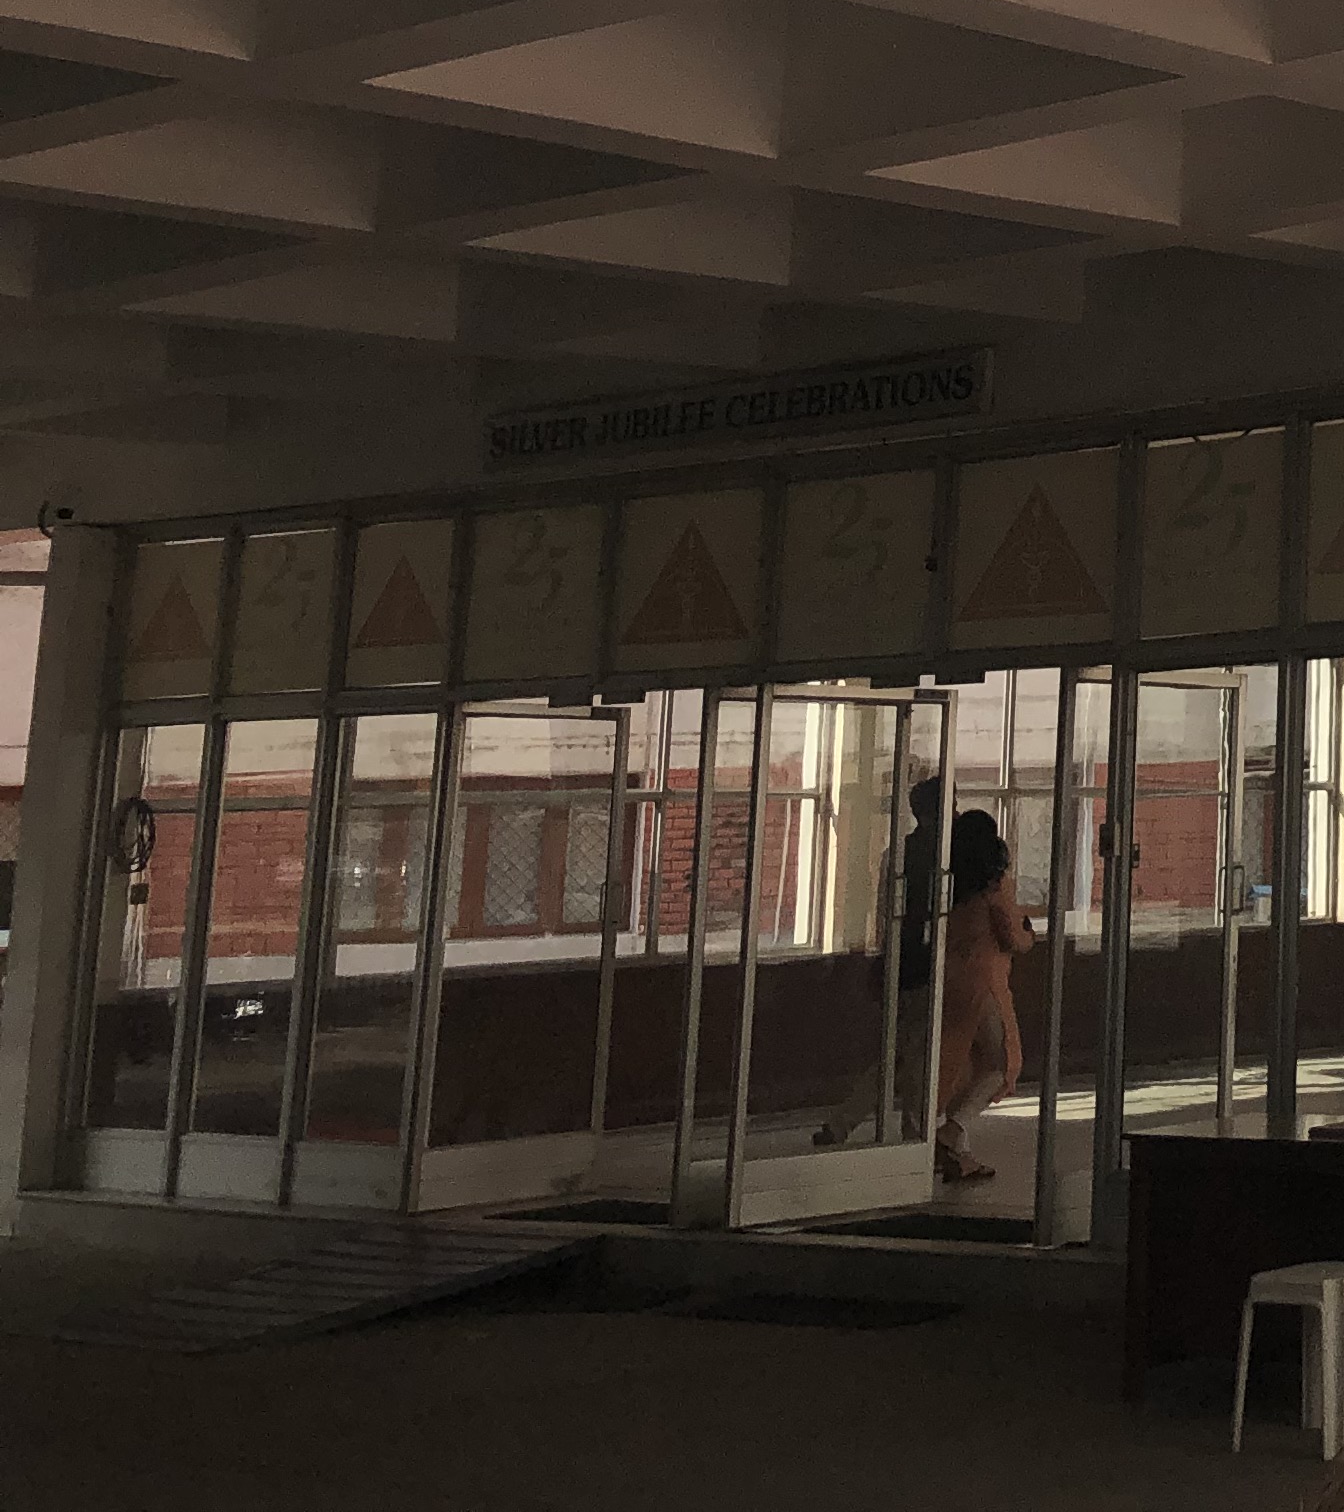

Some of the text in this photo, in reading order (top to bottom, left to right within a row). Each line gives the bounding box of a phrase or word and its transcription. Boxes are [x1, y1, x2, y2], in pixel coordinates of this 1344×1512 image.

[489, 365, 974, 459] SILVER JUBILEE CELEBRATIONS
